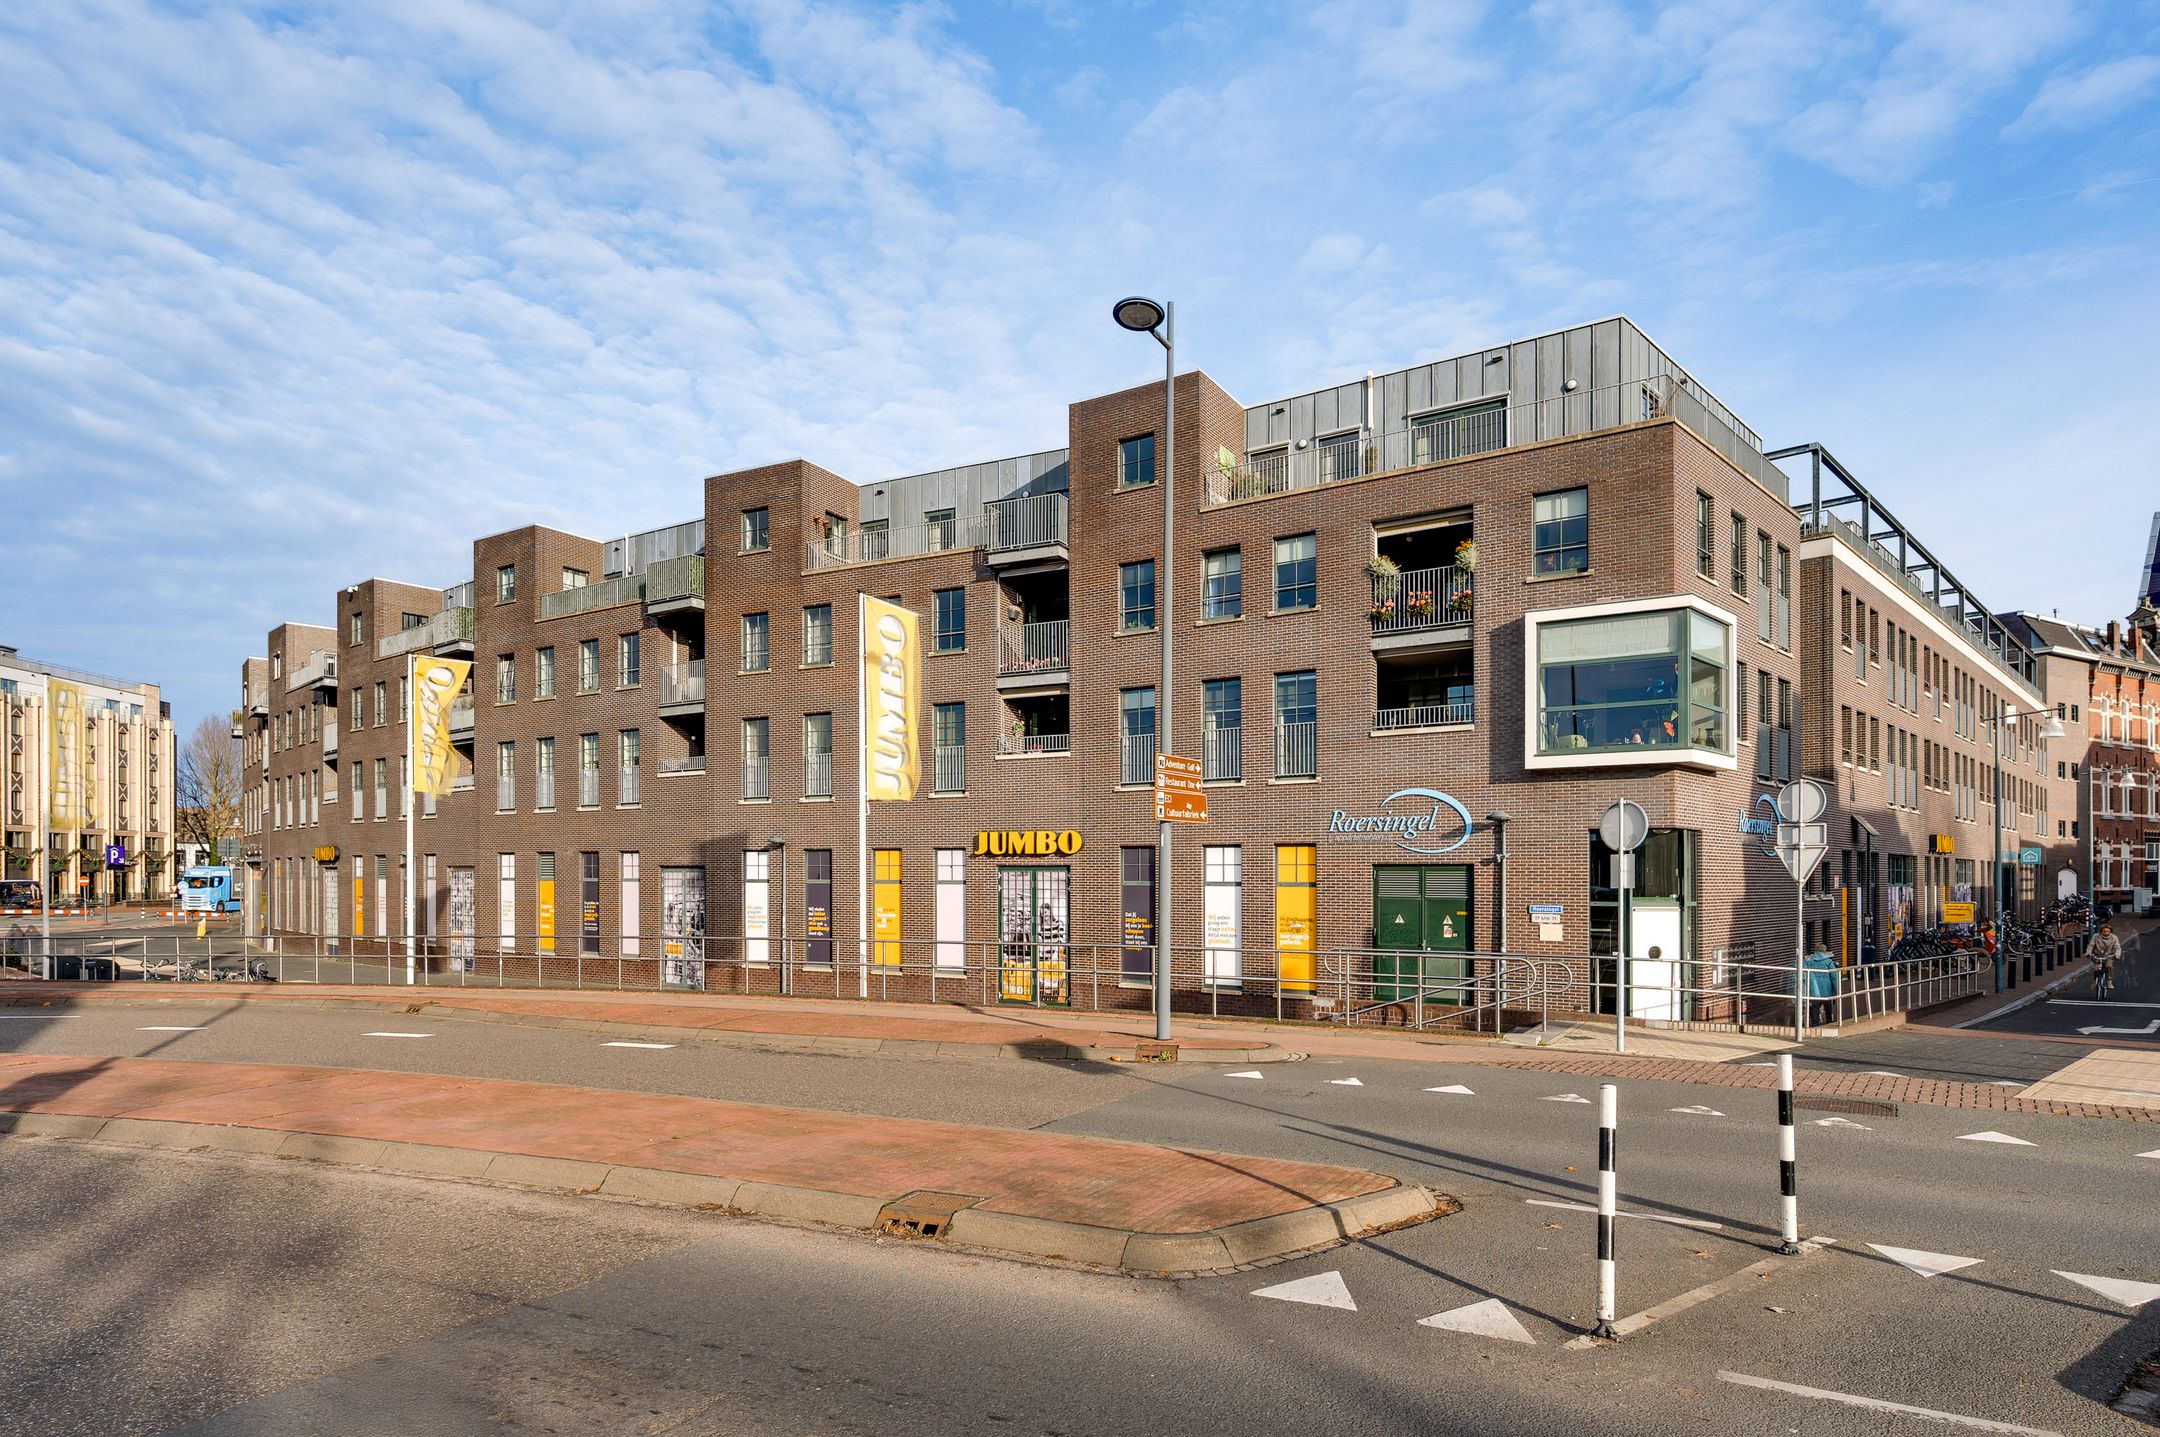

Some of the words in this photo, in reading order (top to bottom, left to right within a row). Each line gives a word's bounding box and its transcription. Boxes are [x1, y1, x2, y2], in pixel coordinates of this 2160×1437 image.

[874, 614, 913, 793] JUMBO
[1166, 760, 1186, 770] Adventure
[1187, 763, 1195, 771] Golf
[1166, 777, 1187, 788] Restaurant
[1329, 806, 1439, 839] Roersingel
[974, 830, 1083, 855] JUMBO
[314, 845, 336, 862] JUMBO
